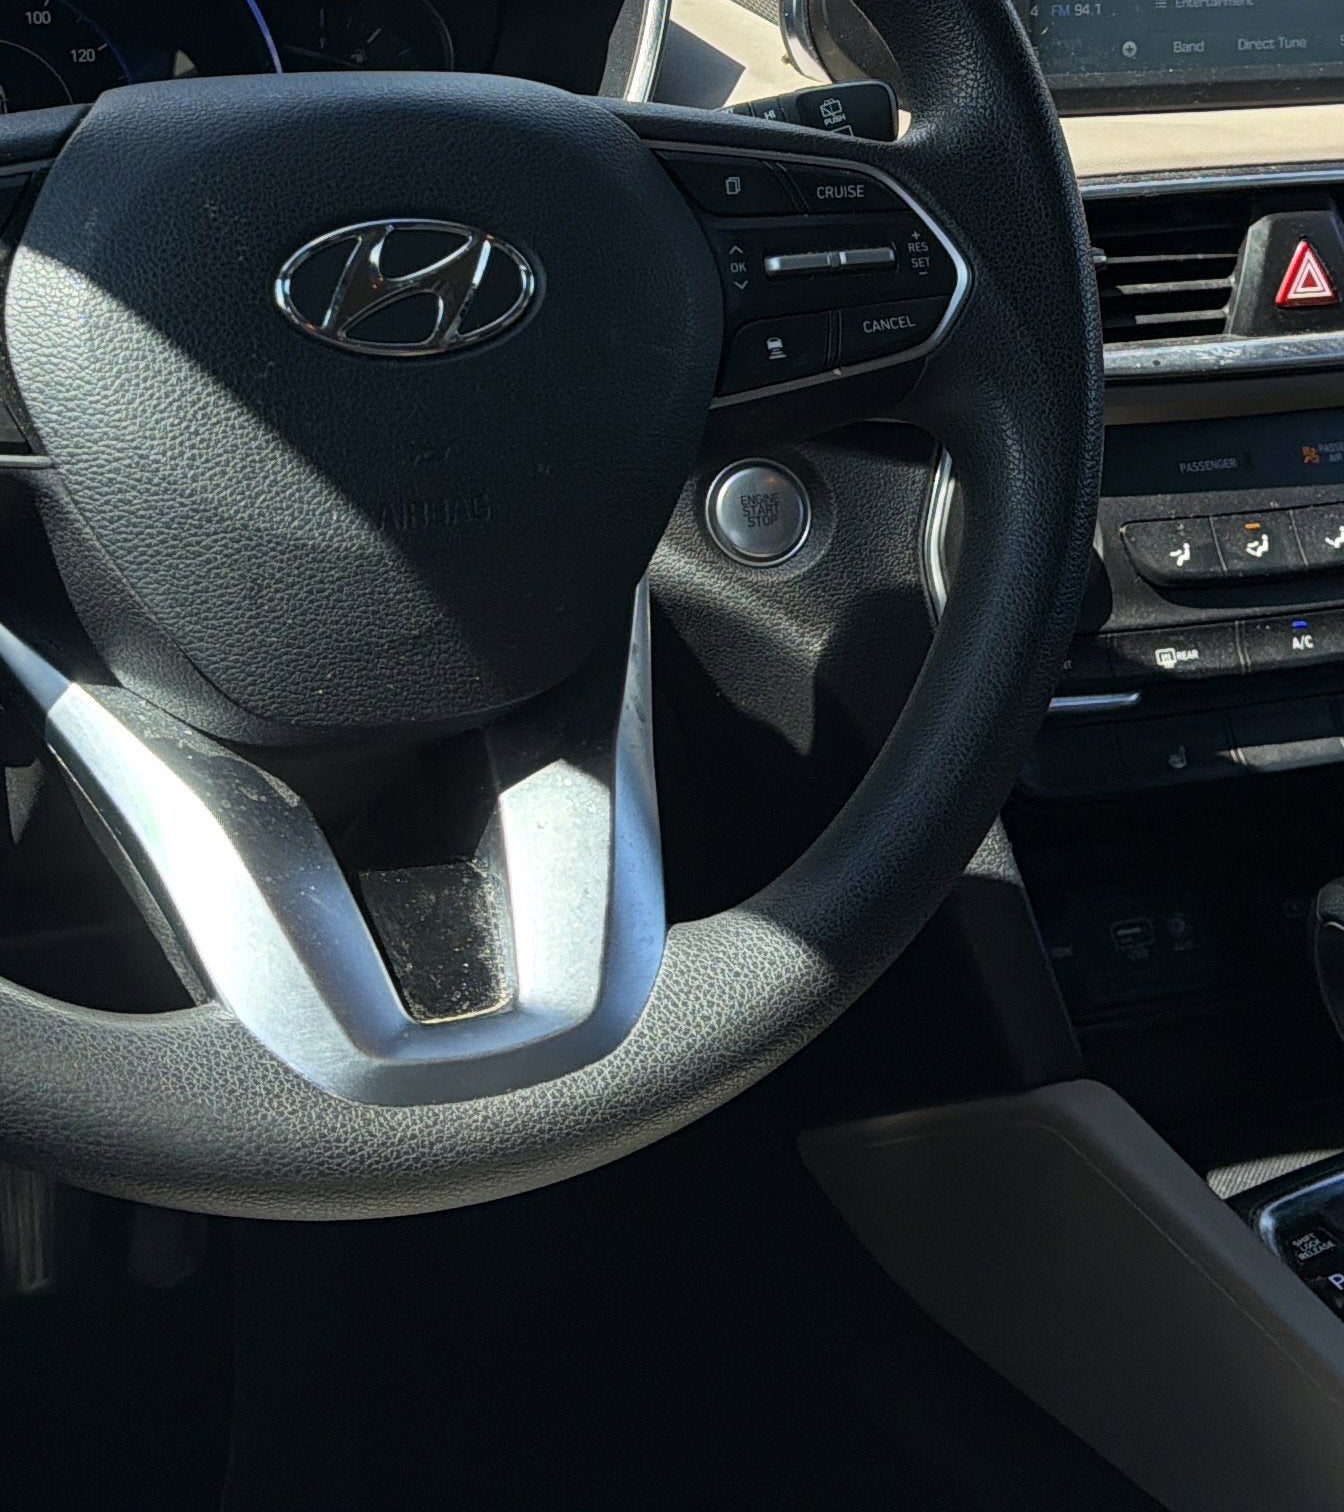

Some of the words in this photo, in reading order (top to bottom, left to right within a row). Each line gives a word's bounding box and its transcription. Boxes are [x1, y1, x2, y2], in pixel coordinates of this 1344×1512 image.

[1030, 5, 1039, 17] 4
[1050, 4, 1070, 16] FM
[1074, 3, 1102, 16] 94.1
[26, 11, 51, 25] 100
[1173, 41, 1205, 53] Band
[1238, 38, 1275, 51] Direct
[1278, 36, 1308, 49] Tune
[71, 49, 96, 63] 120
[816, 185, 864, 200] CRUISE
[908, 242, 928, 253] RES
[730, 262, 747, 273] OK
[911, 257, 930, 269] SET
[863, 316, 916, 333] CANCEL
[1179, 458, 1237, 473] PASSENGER
[740, 493, 780, 505] ENGINE
[742, 502, 780, 517] START
[747, 516, 778, 527] STOP
[1292, 635, 1313, 650] A/C
[1176, 649, 1199, 660] REAR
